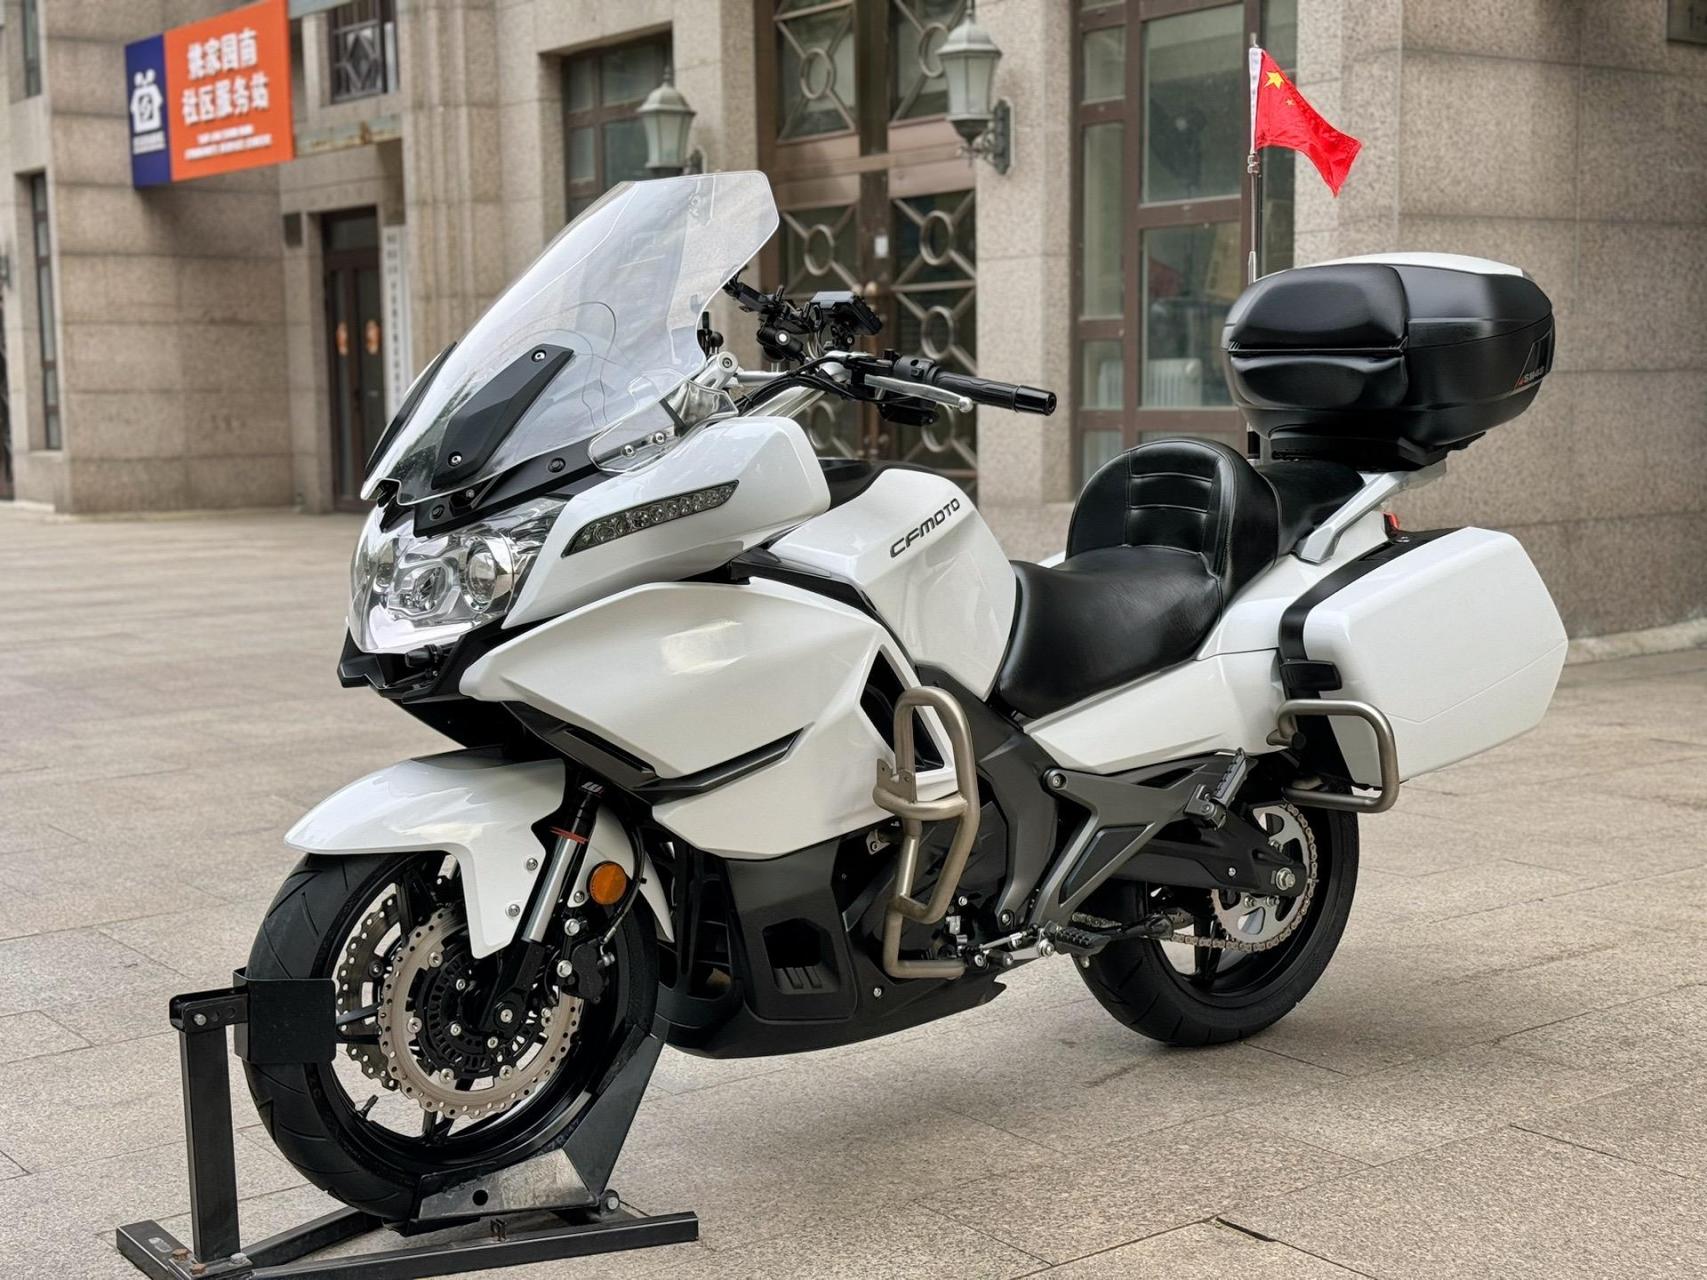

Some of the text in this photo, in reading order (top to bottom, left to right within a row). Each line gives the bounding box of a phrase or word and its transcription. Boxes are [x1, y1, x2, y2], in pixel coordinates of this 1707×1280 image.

[181, 70, 270, 126] 社区服务站
[889, 497, 960, 558] CFMOTO
